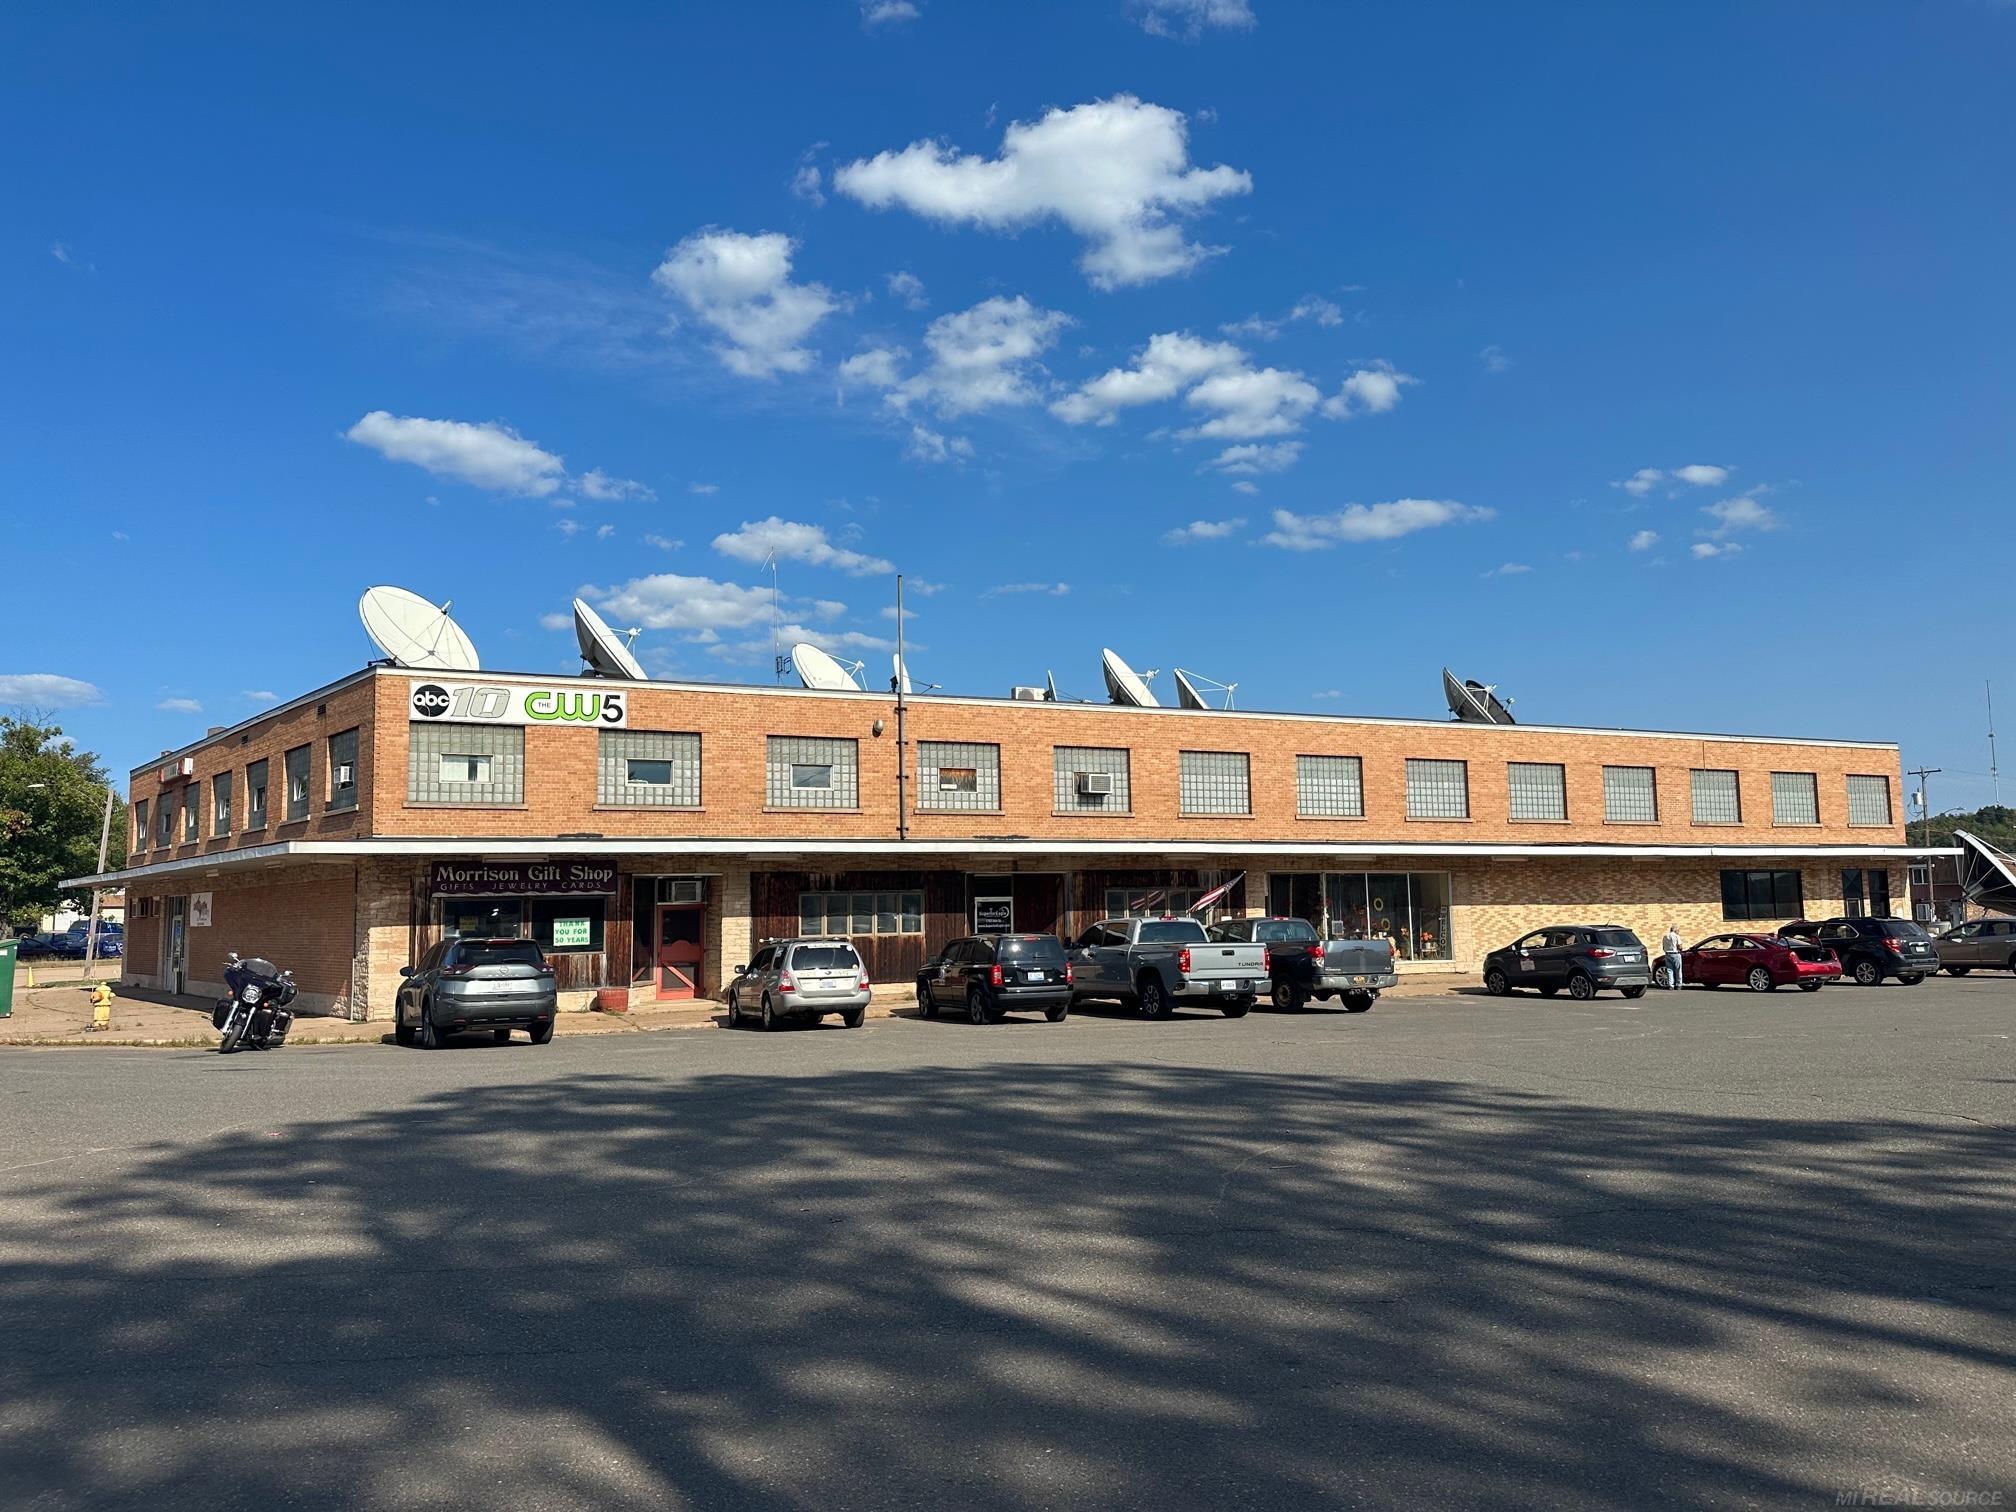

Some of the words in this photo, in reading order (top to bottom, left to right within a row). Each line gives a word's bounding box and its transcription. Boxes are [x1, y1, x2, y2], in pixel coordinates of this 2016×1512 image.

[413, 691, 450, 707] abc
[451, 687, 510, 718] 10
[524, 691, 600, 721] CW
[601, 694, 624, 723] 5
[436, 866, 519, 882] Morrison
[528, 865, 561, 881] Gift
[570, 865, 613, 883] Shop
[440, 883, 475, 891] GIFTS
[492, 882, 547, 890] JEWELRY
